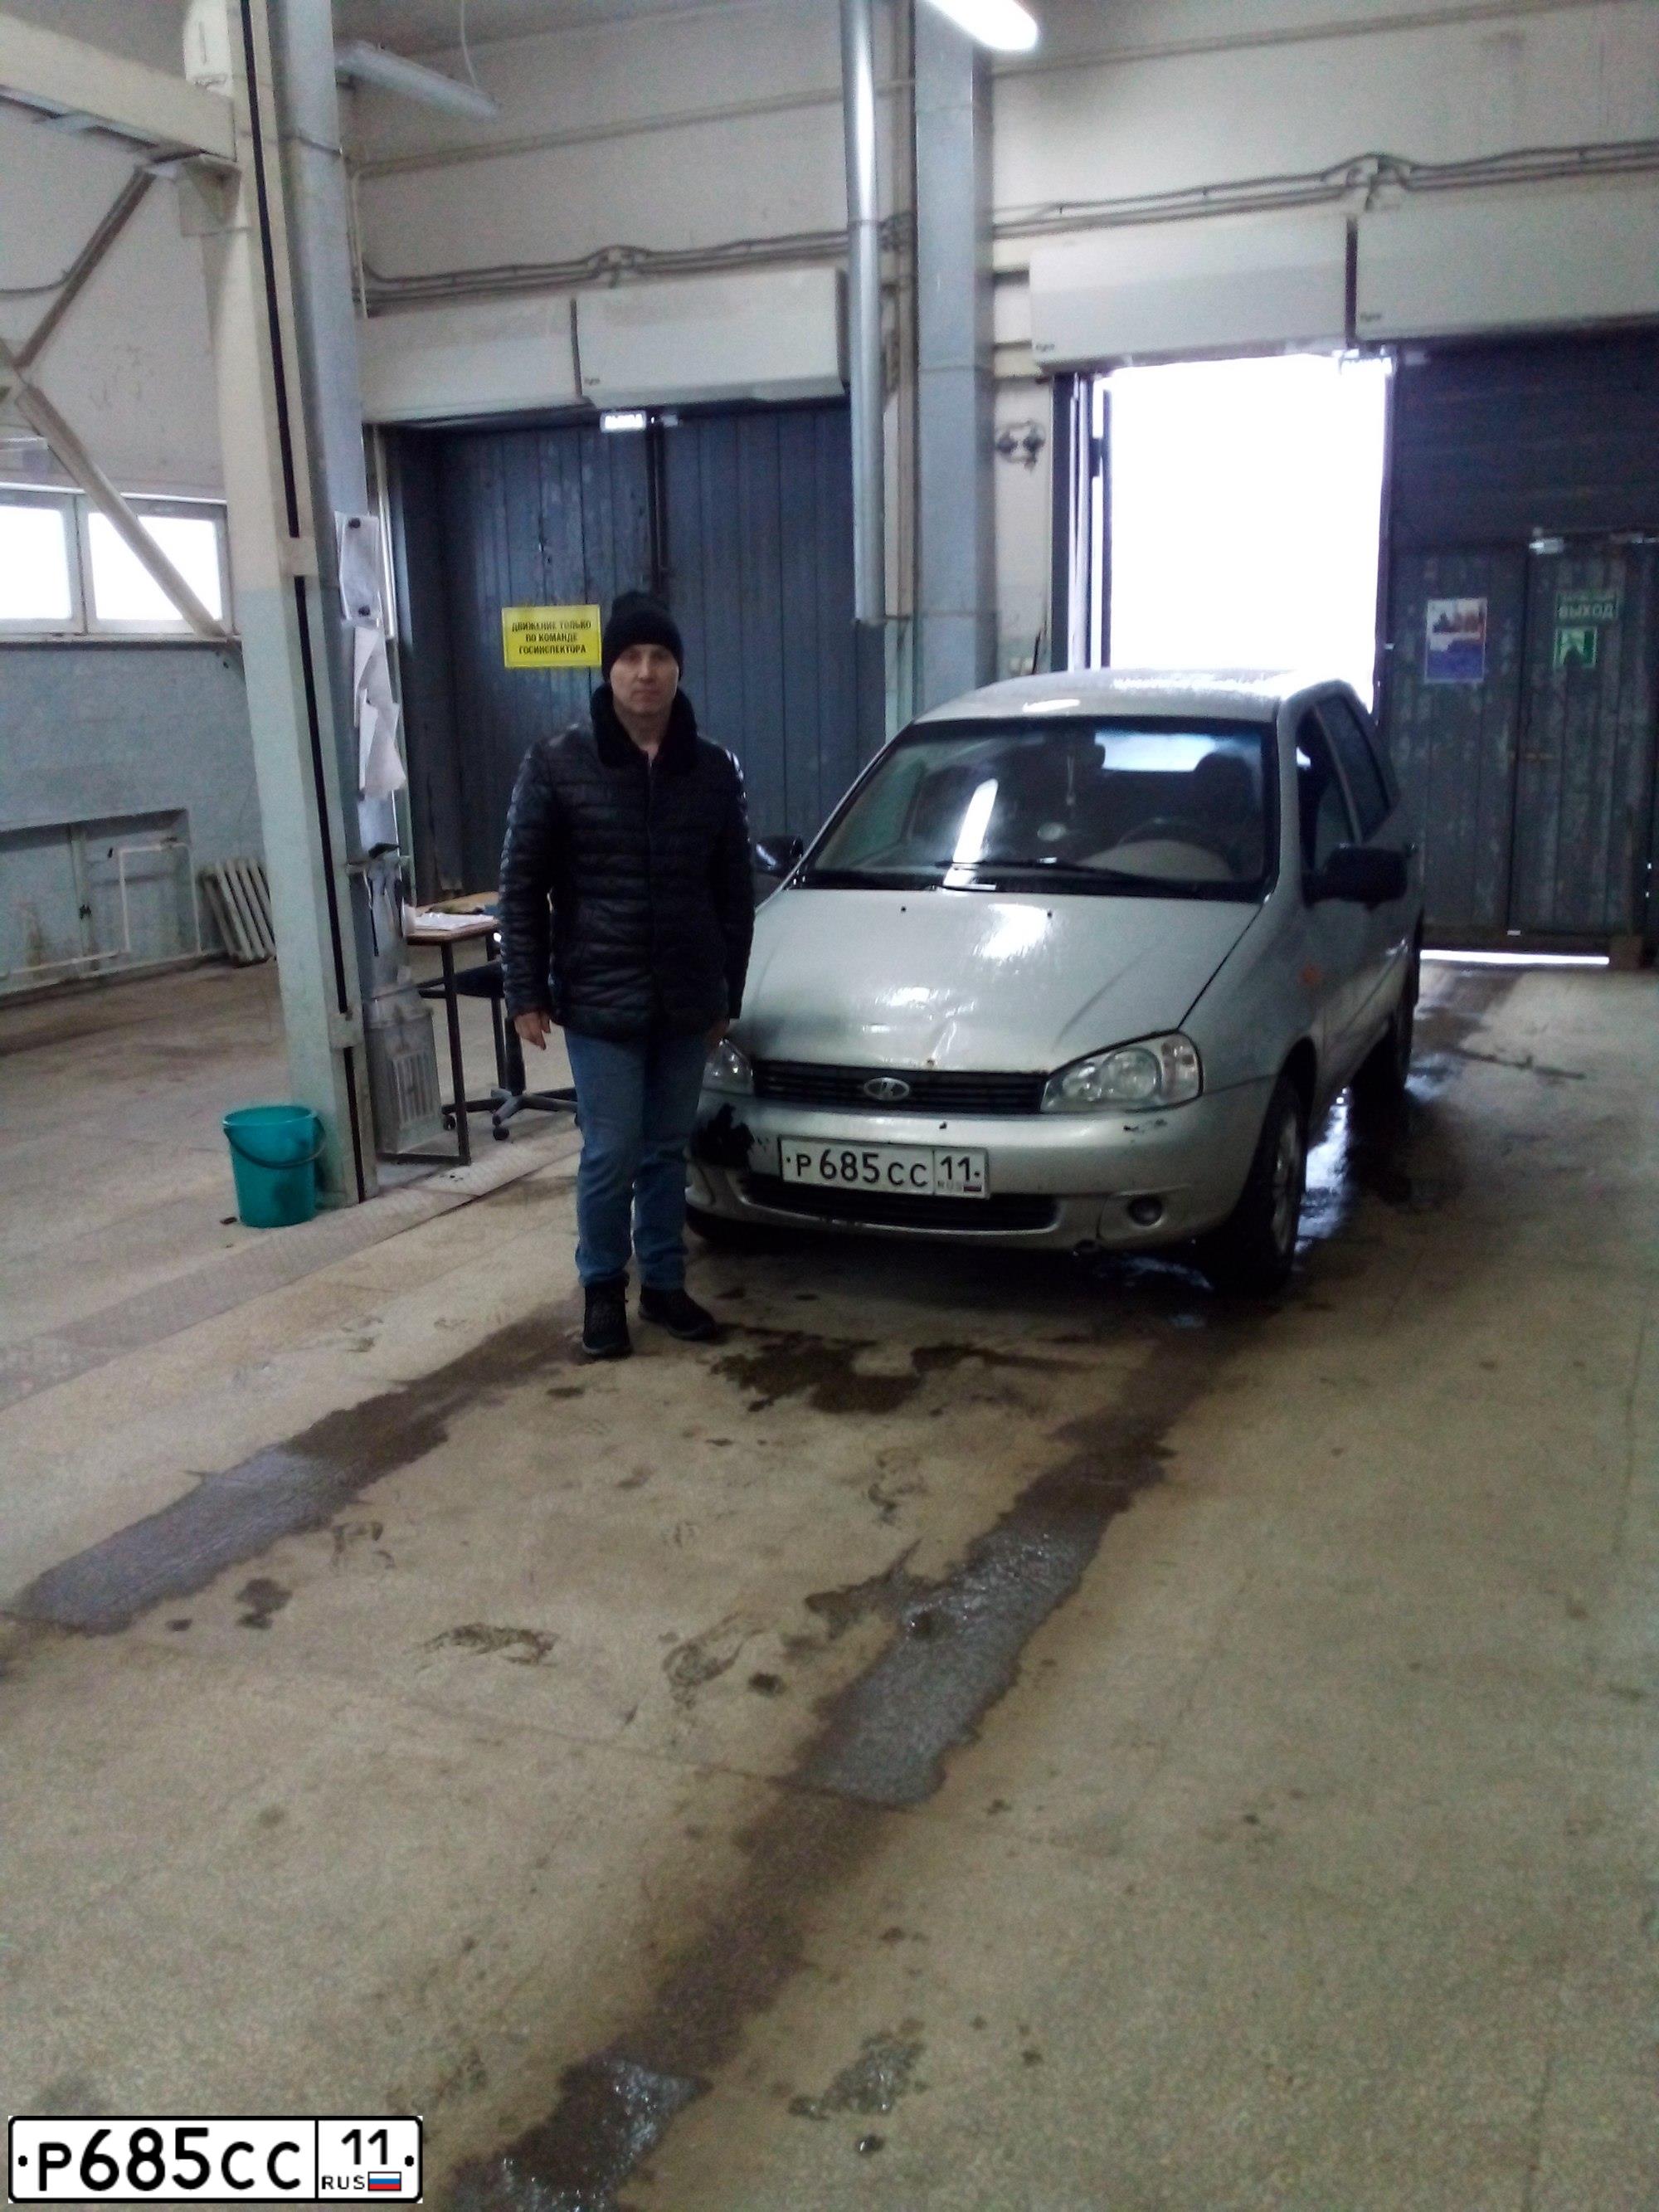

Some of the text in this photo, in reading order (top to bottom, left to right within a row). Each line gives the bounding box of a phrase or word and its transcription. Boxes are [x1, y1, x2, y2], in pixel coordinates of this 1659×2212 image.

[526, 632, 578, 642] ПО КОМАНДЕ
[519, 645, 586, 655] ГОСИНСПЕКТОРА
[940, 1156, 970, 1182] 11
